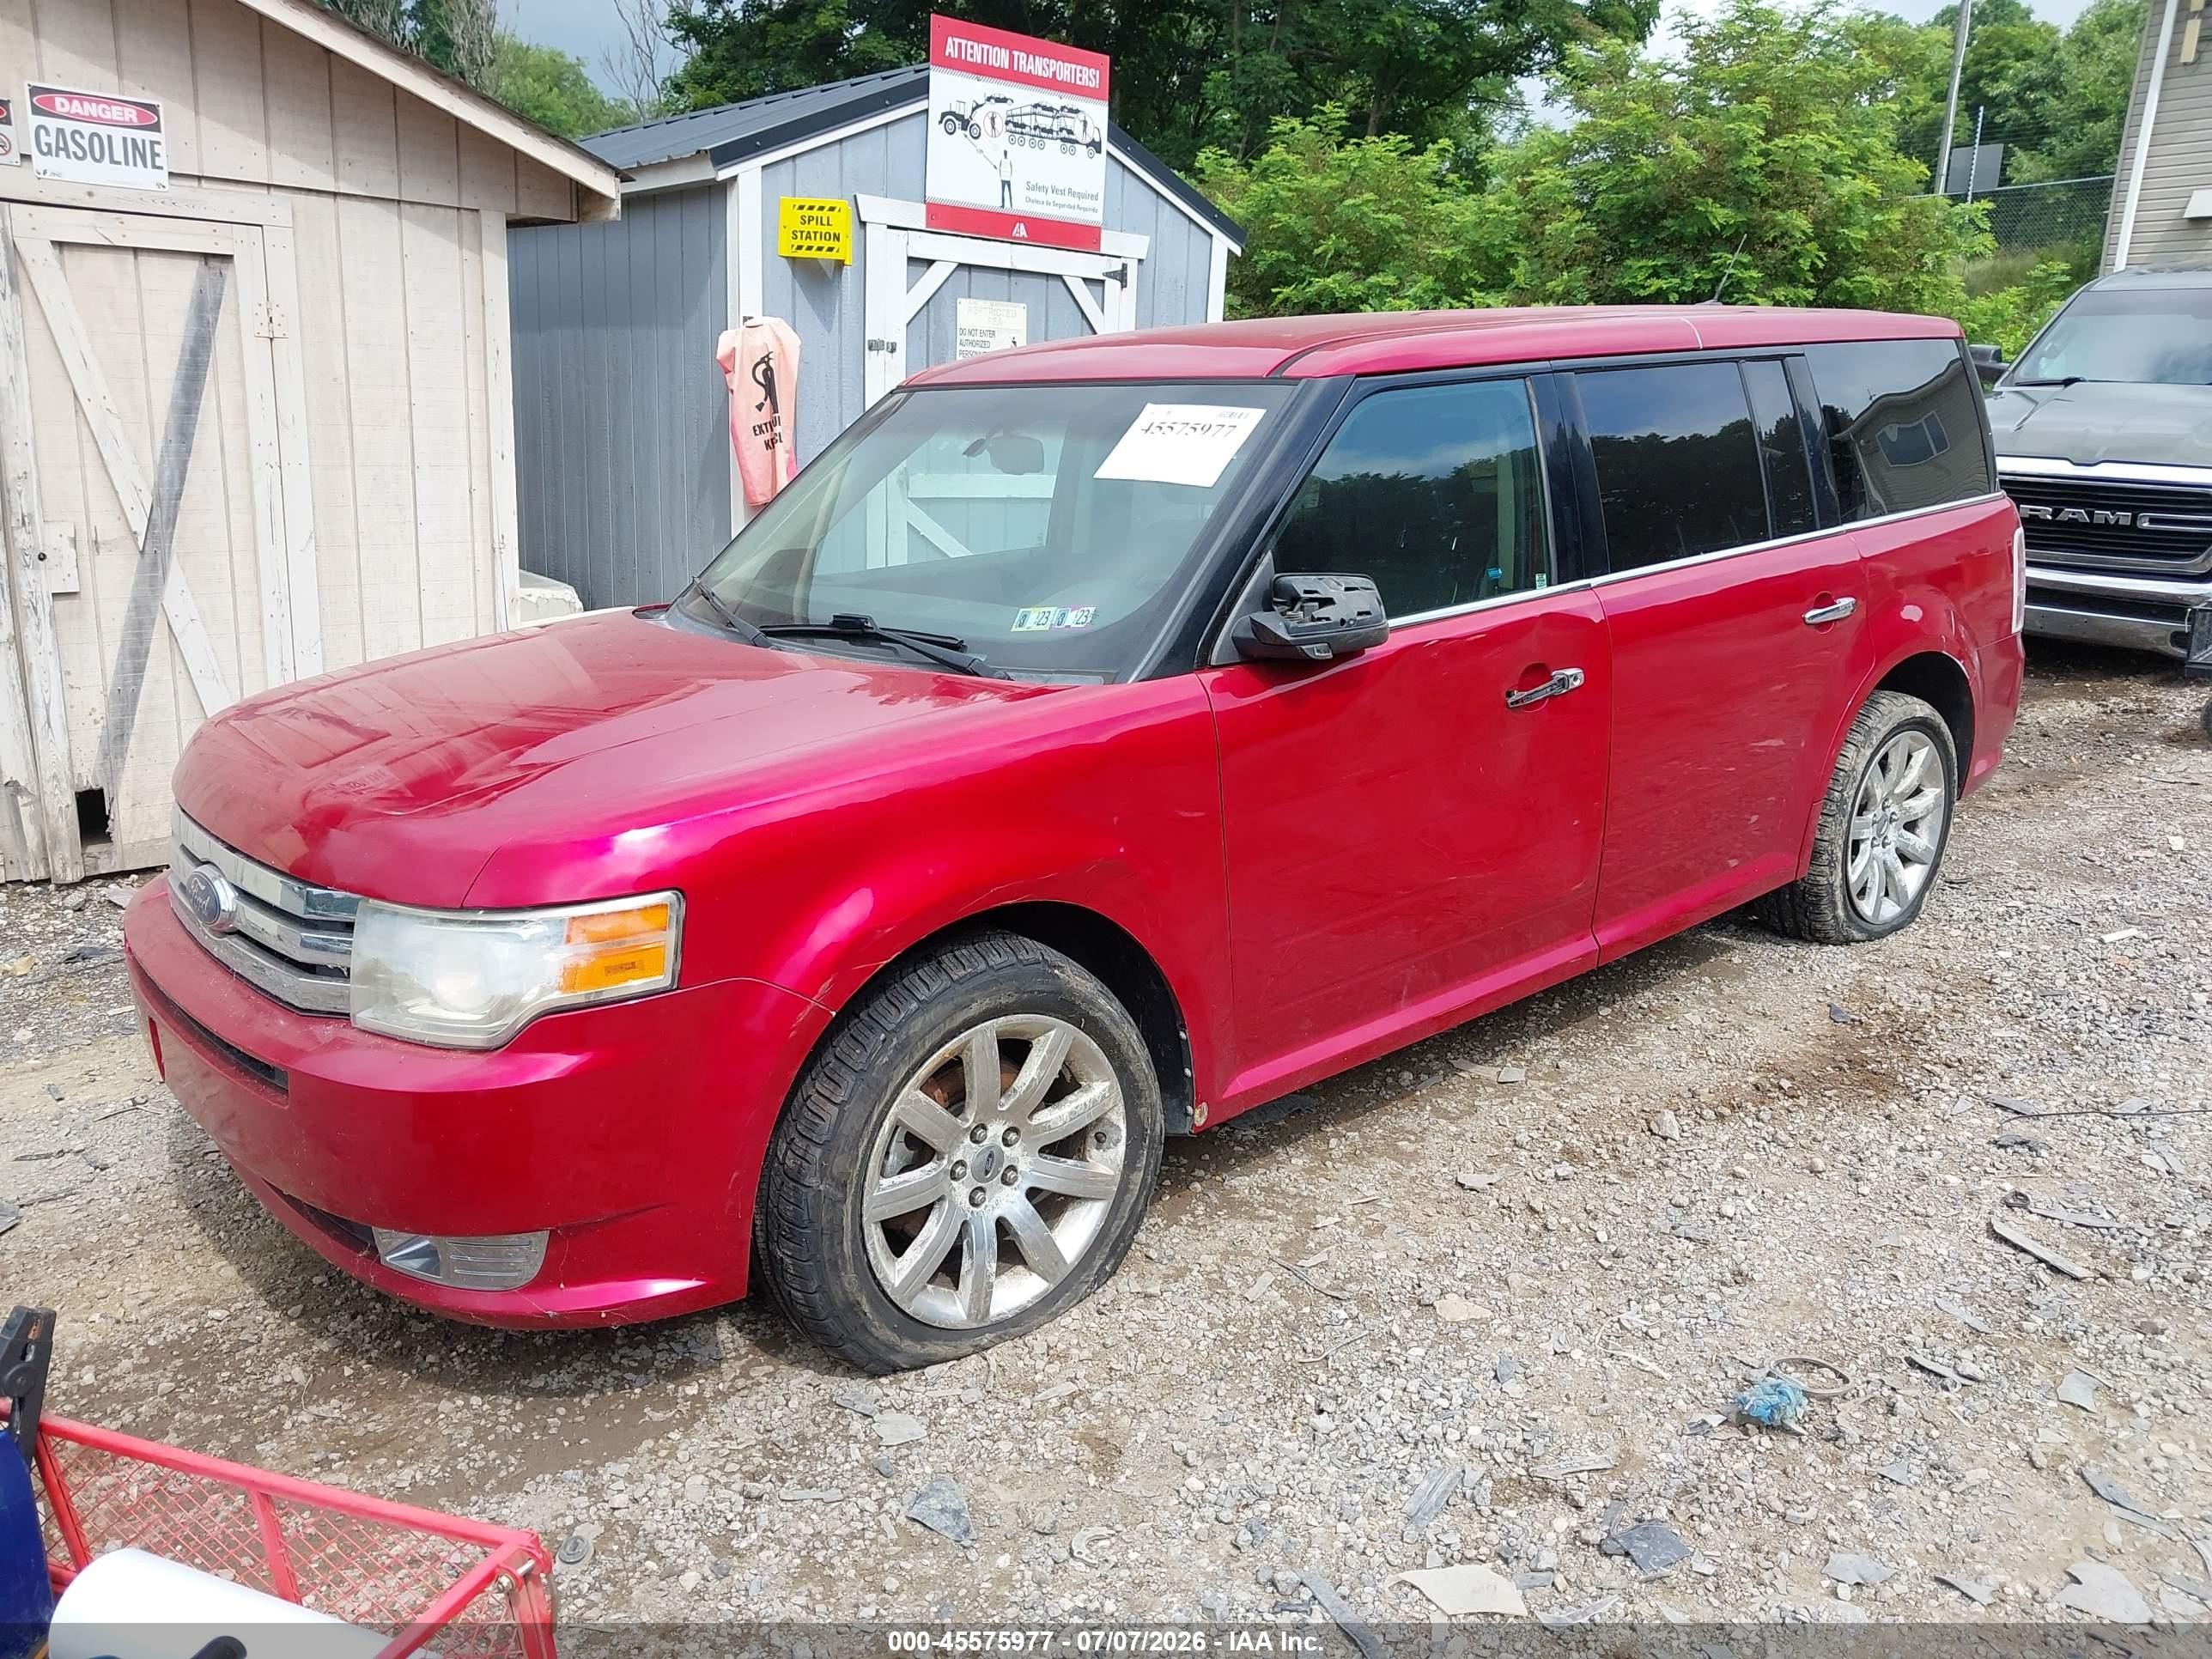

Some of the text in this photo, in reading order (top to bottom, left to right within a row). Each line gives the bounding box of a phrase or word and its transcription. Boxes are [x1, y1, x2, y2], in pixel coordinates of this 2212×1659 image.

[945, 36, 1099, 88] ATTENTION TRANSPORTERS!
[54, 96, 137, 124] DANGER
[34, 124, 164, 170] GASOLINE
[1025, 180, 1098, 201] Safety Vest Required
[799, 215, 833, 227] SPILL
[791, 229, 841, 242] STATION
[958, 327, 996, 338] DO NOT ENTER
[959, 338, 991, 349] AUTHORIZED
[1140, 421, 1237, 438] 45575977
[2019, 504, 2132, 526] RAM
